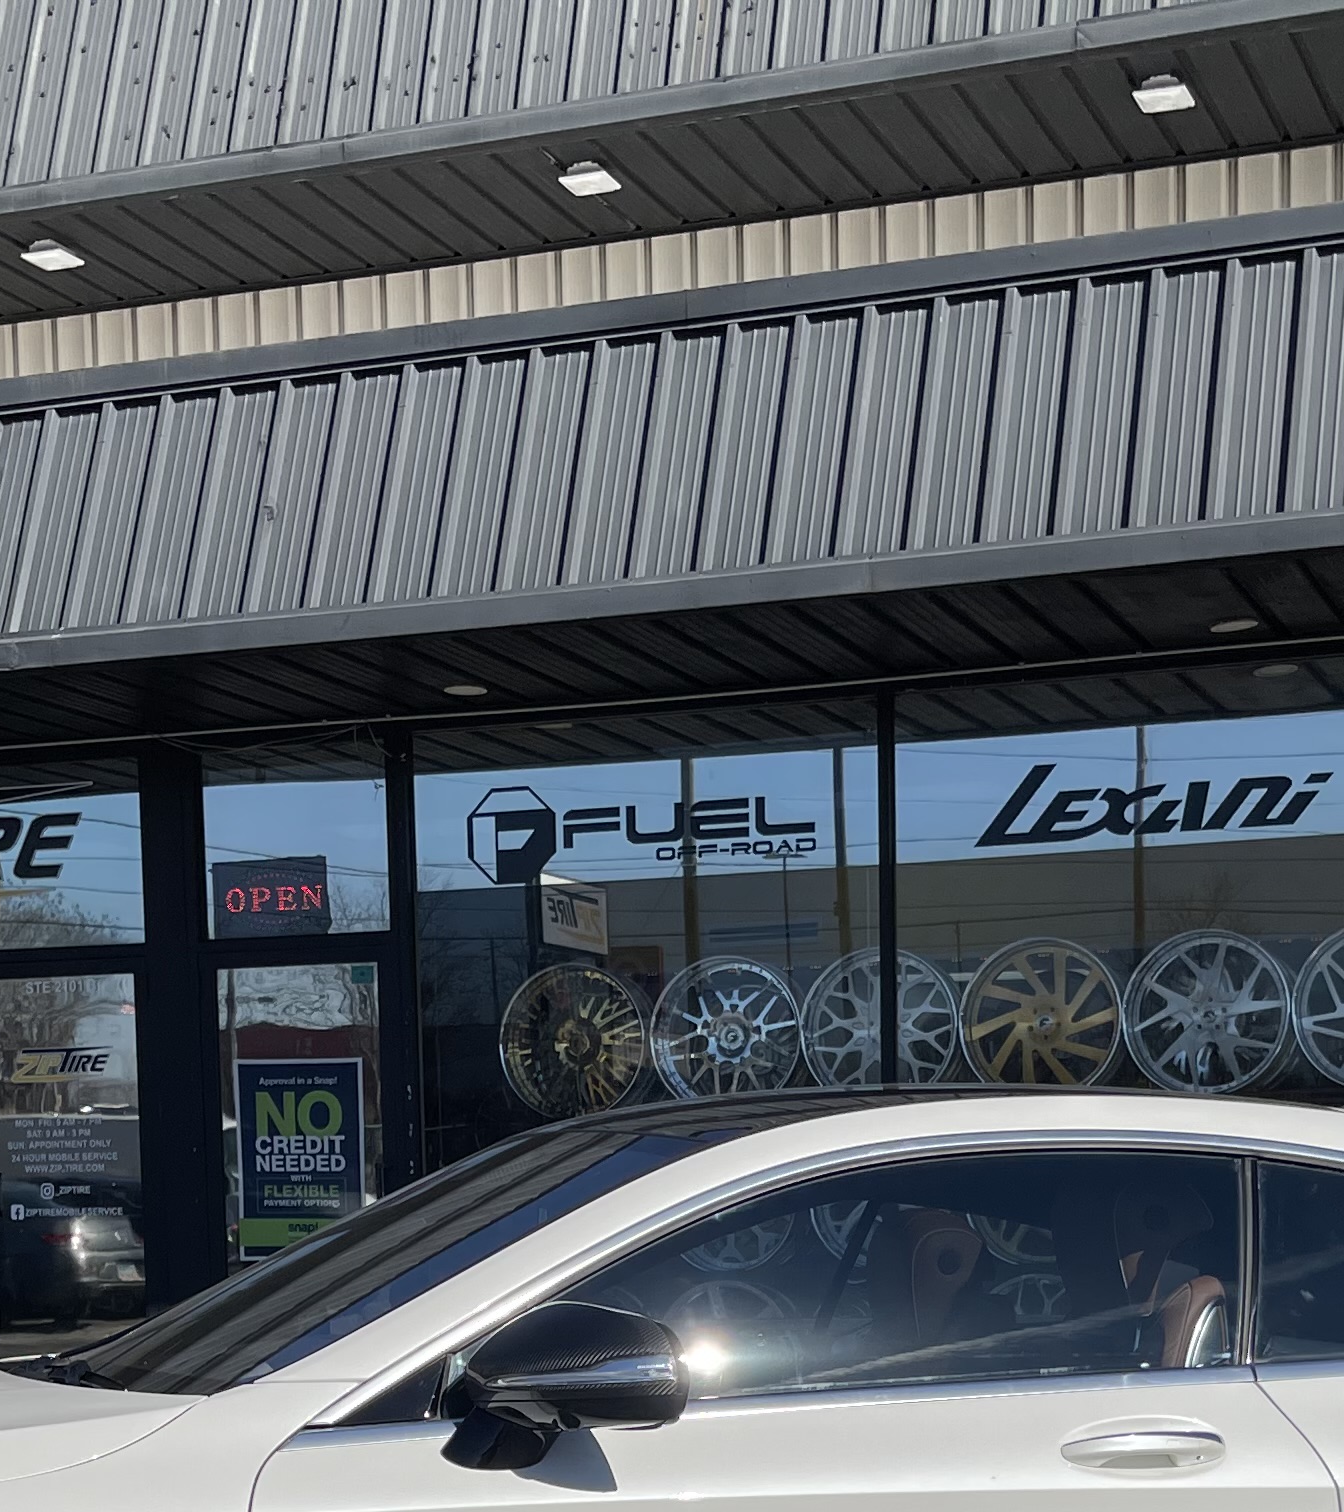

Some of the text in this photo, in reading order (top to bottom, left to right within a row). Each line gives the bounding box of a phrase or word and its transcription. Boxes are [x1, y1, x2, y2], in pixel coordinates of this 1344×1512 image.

[563, 796, 817, 850] FUEL
[655, 837, 817, 862] OFF-ROAD
[225, 884, 323, 913] OPEN
[25, 981, 51, 994] STE
[259, 1077, 296, 1086] Approval
[297, 1077, 305, 1085] in
[314, 1076, 338, 1086] Snap!
[256, 1090, 343, 1139] NO
[52, 1129, 65, 1137] AM
[78, 1128, 91, 1137] PM
[28, 1140, 87, 1149] APPOINTMENT
[89, 1139, 112, 1148] ONLY
[256, 1135, 345, 1155] CREDIT
[11, 1151, 118, 1162] 24 HOUR MOBILE SERVICE
[256, 1154, 346, 1173] NEEDED
[290, 1174, 312, 1182] WITH
[264, 1184, 340, 1198] FLEXIBLE
[264, 1199, 301, 1207] PAYMENT
